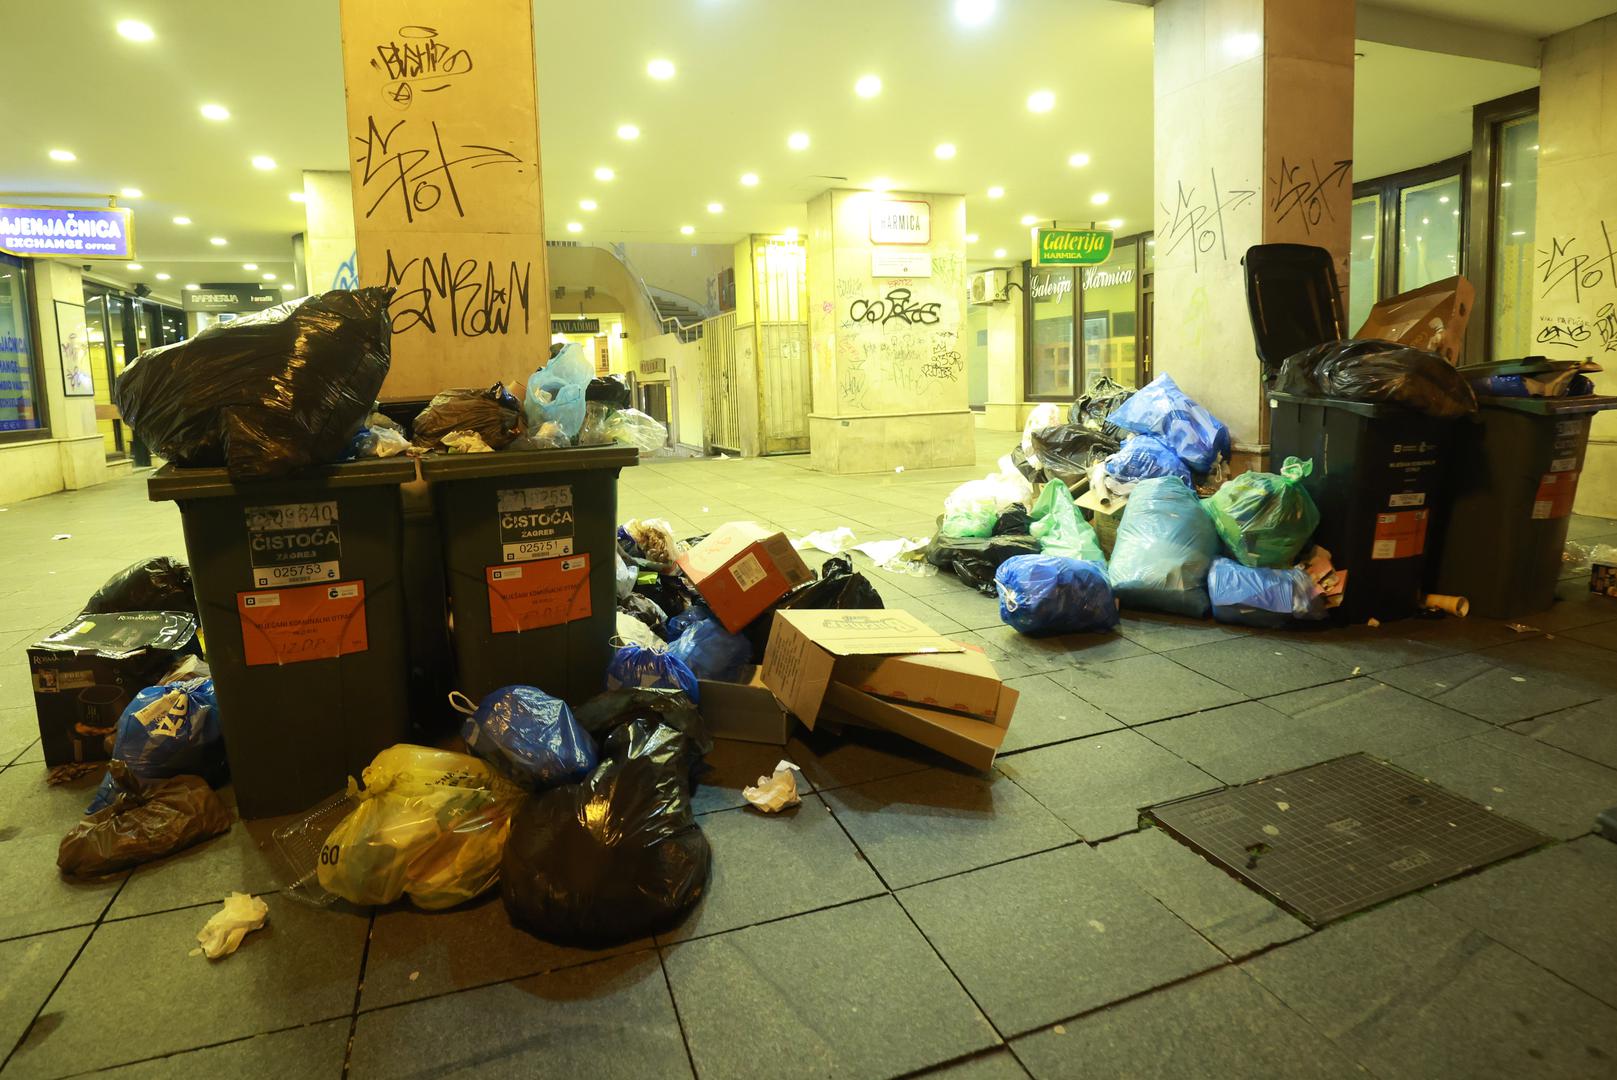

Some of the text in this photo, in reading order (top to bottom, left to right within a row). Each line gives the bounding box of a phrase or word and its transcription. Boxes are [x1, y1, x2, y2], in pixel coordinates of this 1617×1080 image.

[881, 214, 921, 231] HARMICA
[5, 237, 116, 251] EXCHANGE OFFICE
[1043, 233, 1105, 253] Galerija
[1031, 267, 1134, 304] Galerija Harmica
[502, 509, 573, 529] ČISTOĆA
[252, 528, 339, 551] ČISTOĆA
[521, 528, 555, 538] ZAGREB
[519, 540, 558, 554] 025751
[273, 564, 322, 578] 025753
[320, 845, 340, 866] 60
